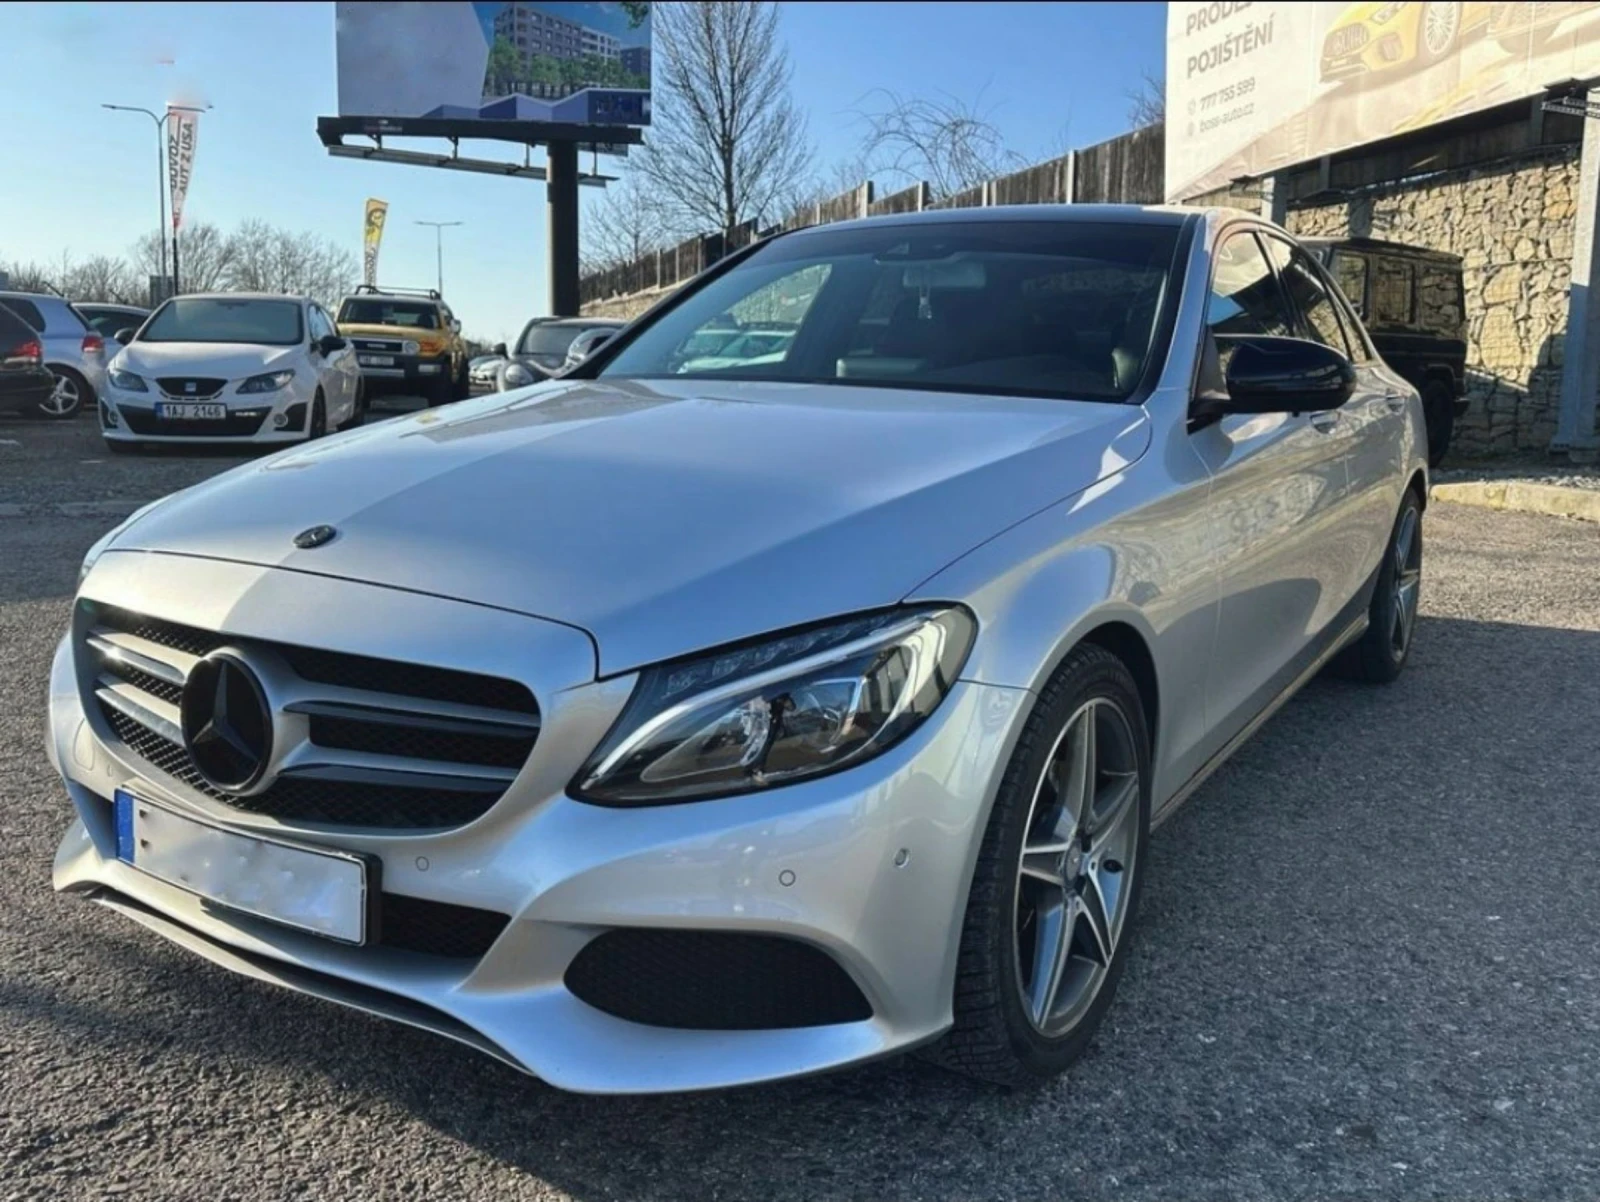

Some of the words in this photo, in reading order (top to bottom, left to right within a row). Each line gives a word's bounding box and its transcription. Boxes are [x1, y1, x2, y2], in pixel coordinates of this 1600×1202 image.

[1187, 11, 1276, 79] POJIŠTĚNÍ
[182, 123, 193, 151] USA
[181, 153, 191, 163] Z
[179, 165, 189, 195] AUT
